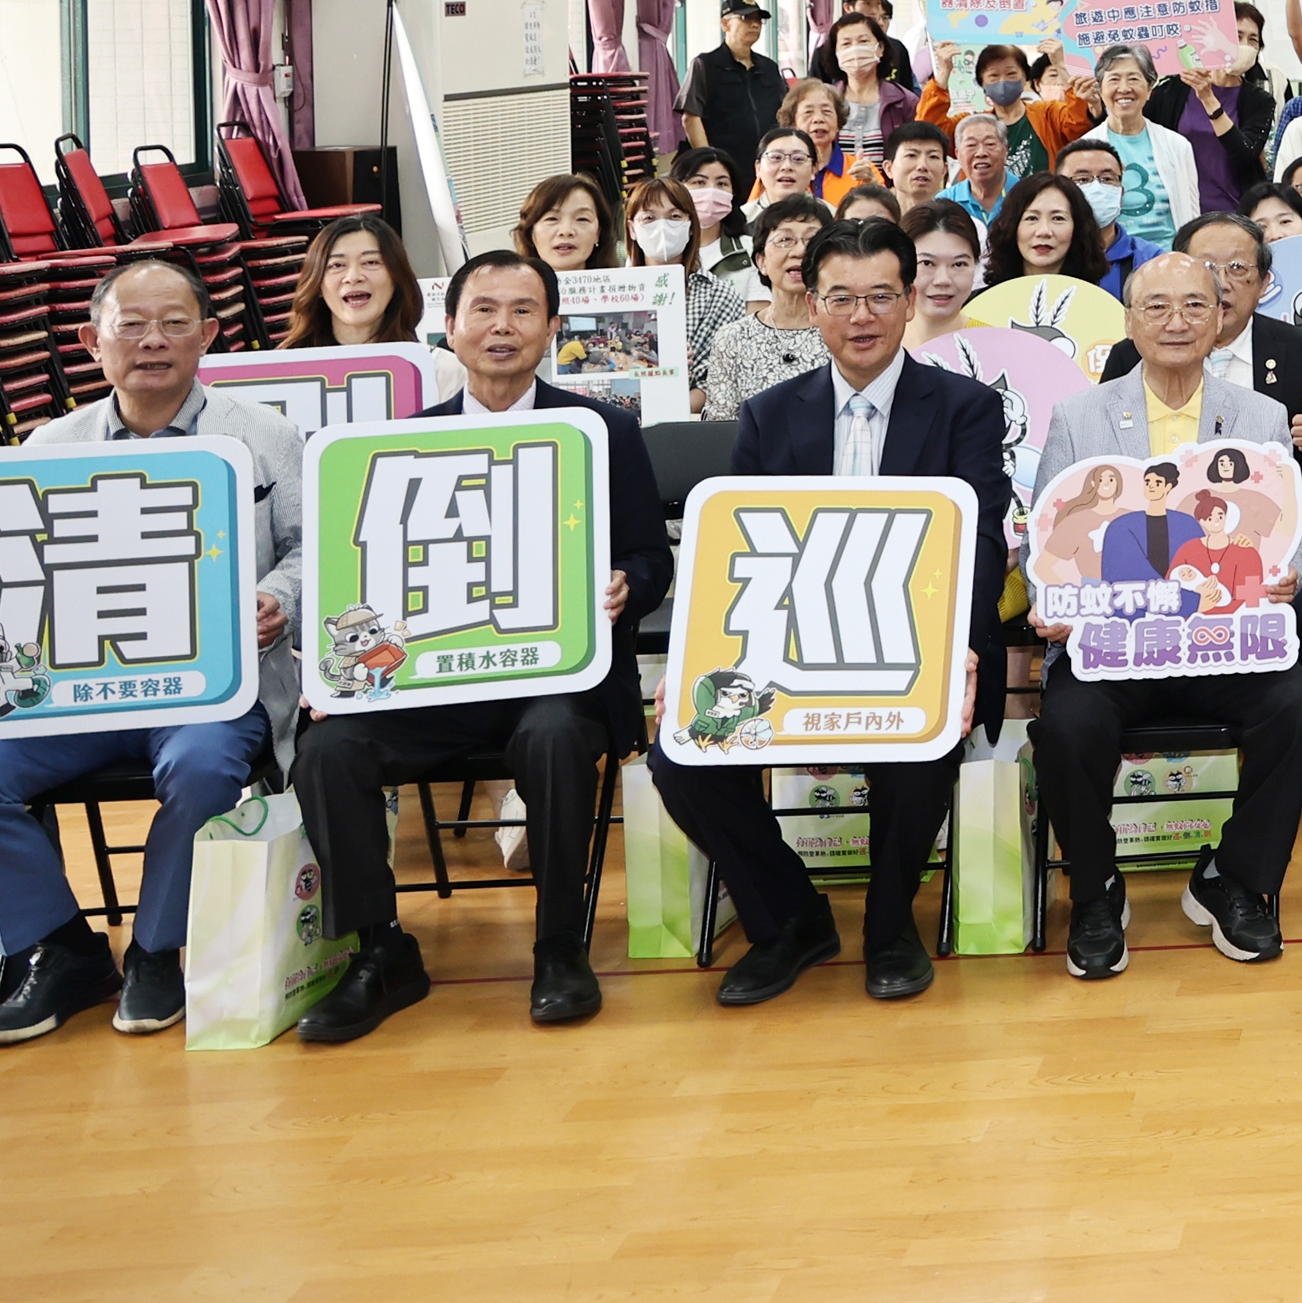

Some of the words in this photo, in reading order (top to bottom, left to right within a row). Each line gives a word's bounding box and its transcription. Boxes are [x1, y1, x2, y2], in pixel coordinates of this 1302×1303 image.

[445, 3, 465, 15] TECO
[358, 443, 558, 634] 倒
[0, 477, 196, 668] 清
[731, 510, 927, 693] 巡
[1046, 580, 1181, 617] 防蚊不懈
[435, 646, 540, 674] 置積水容器
[1078, 613, 1289, 670] 健康無限
[72, 676, 183, 703] 除不要容器
[802, 711, 904, 733] 視家戶內外
